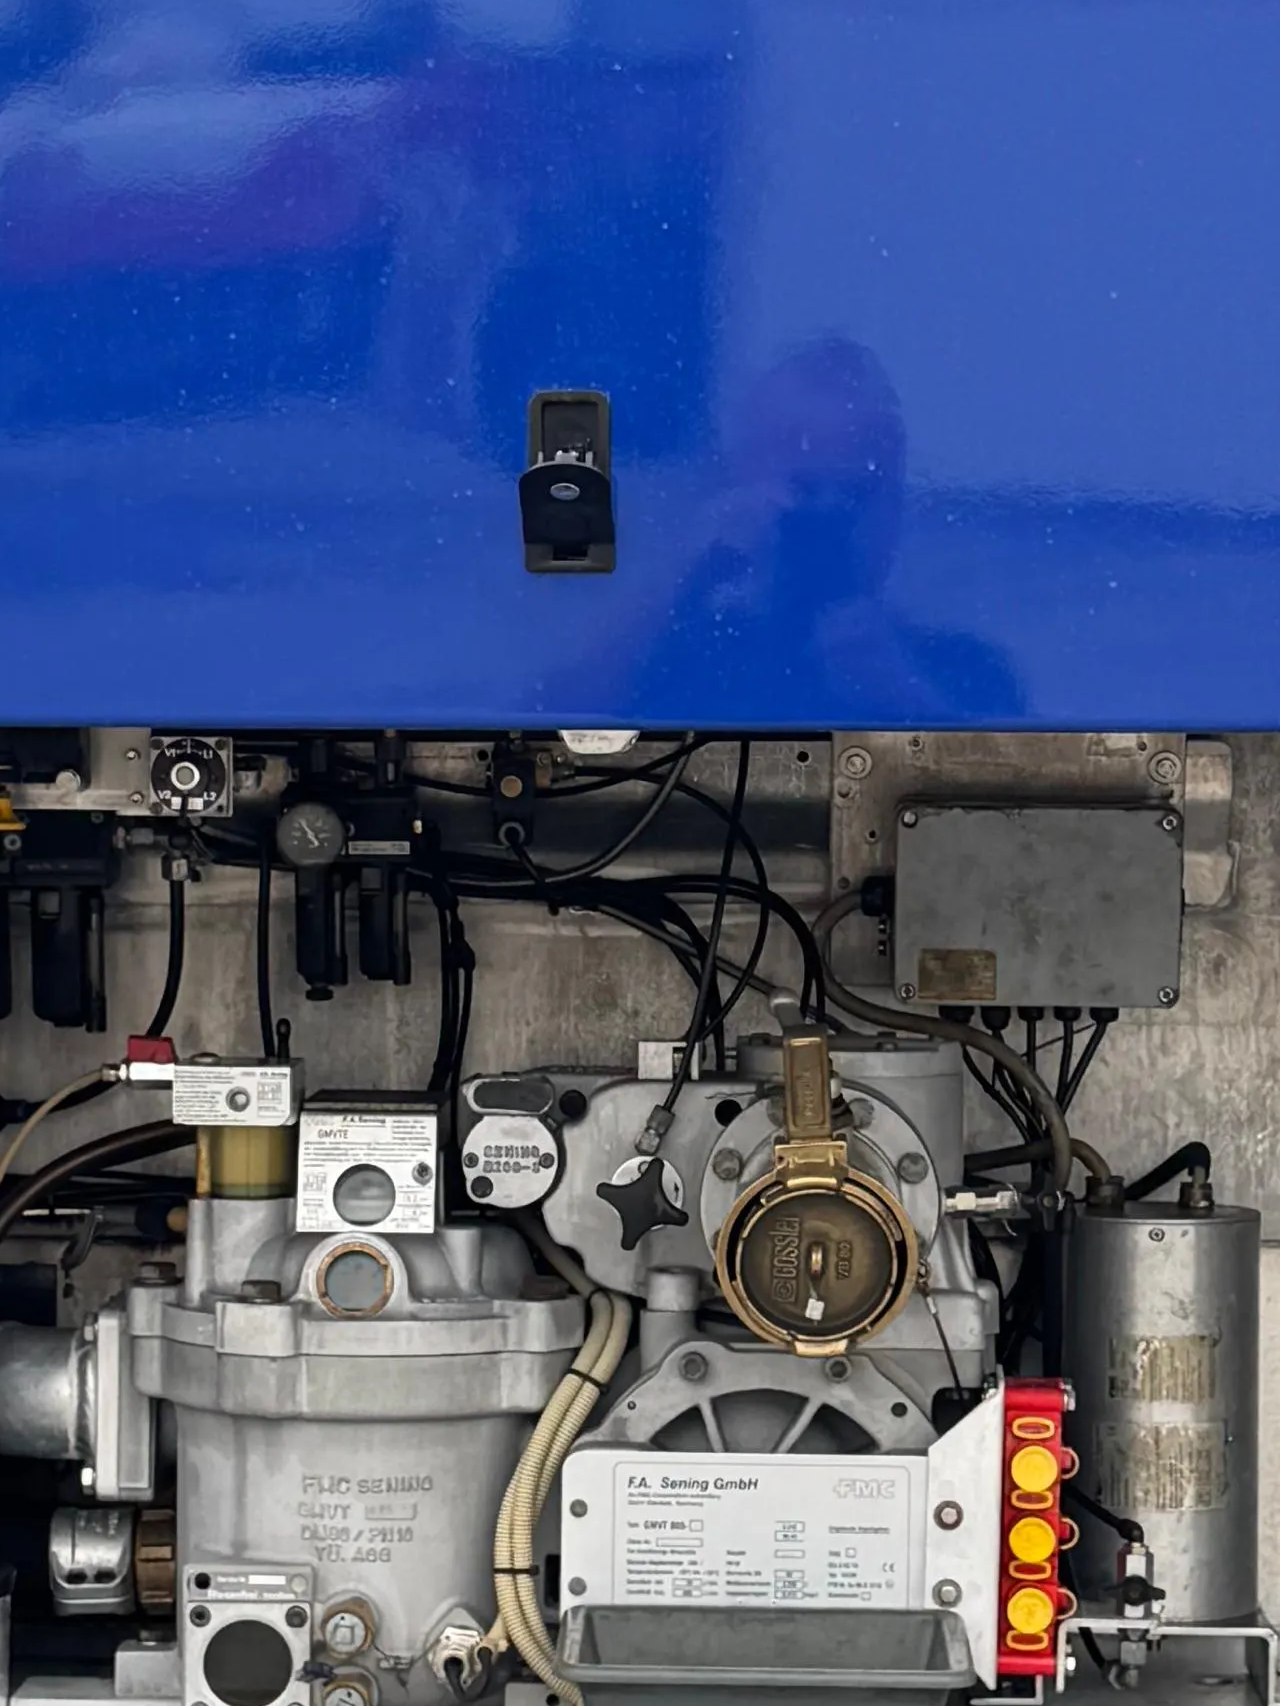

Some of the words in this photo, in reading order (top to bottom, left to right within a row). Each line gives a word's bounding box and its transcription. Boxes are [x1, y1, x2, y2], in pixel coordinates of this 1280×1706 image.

[628, 1476, 652, 1489] F.A.
[660, 1476, 710, 1492] Sening
[713, 1477, 759, 1490] GmbH
